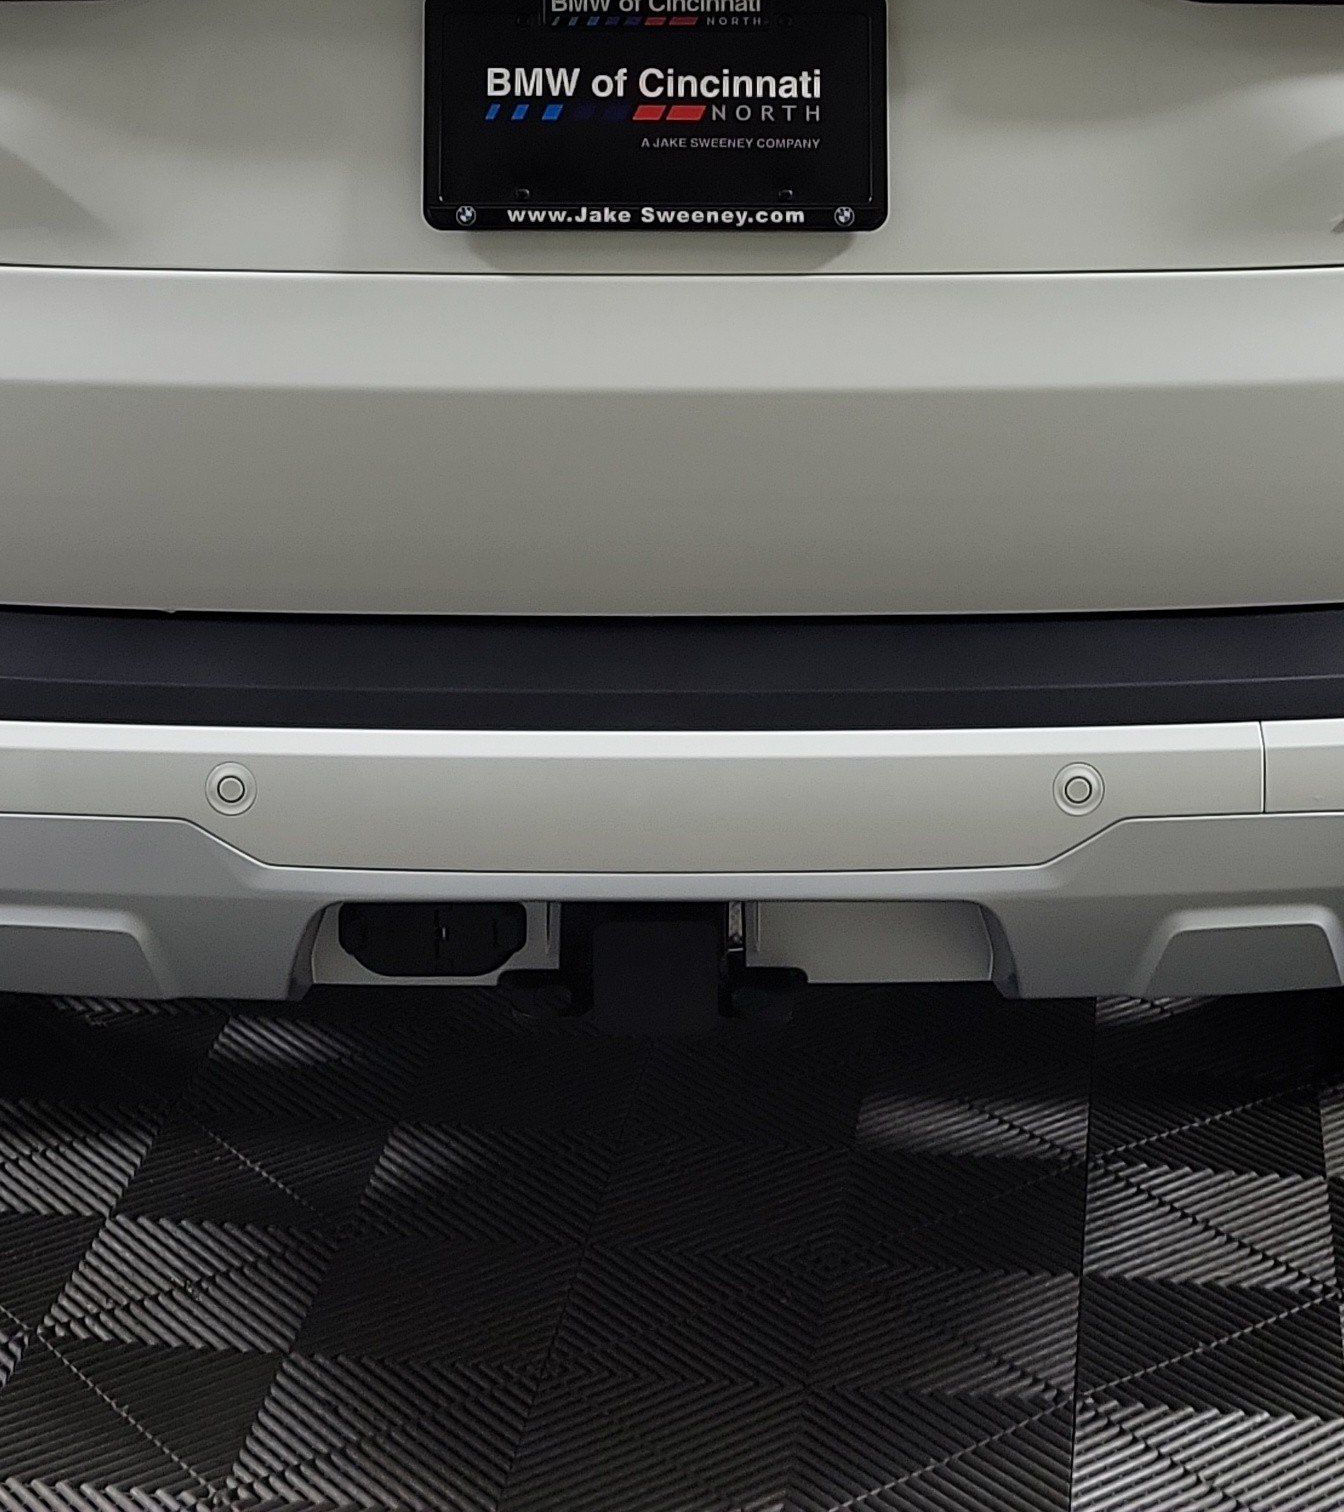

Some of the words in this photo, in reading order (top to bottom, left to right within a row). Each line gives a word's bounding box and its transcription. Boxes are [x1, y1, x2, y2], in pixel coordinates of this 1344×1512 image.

[707, 17, 761, 26] NORTH
[487, 68, 580, 97] BMW
[591, 68, 627, 97] of
[638, 68, 821, 98] Cincinnati
[712, 104, 821, 121] NORTH
[641, 138, 650, 148] A
[653, 138, 687, 148] JAKE
[690, 138, 753, 148] SWEENEY
[757, 138, 820, 149] COMPANY
[507, 207, 631, 224] www.Jake
[641, 207, 804, 228] Sweeney.com
